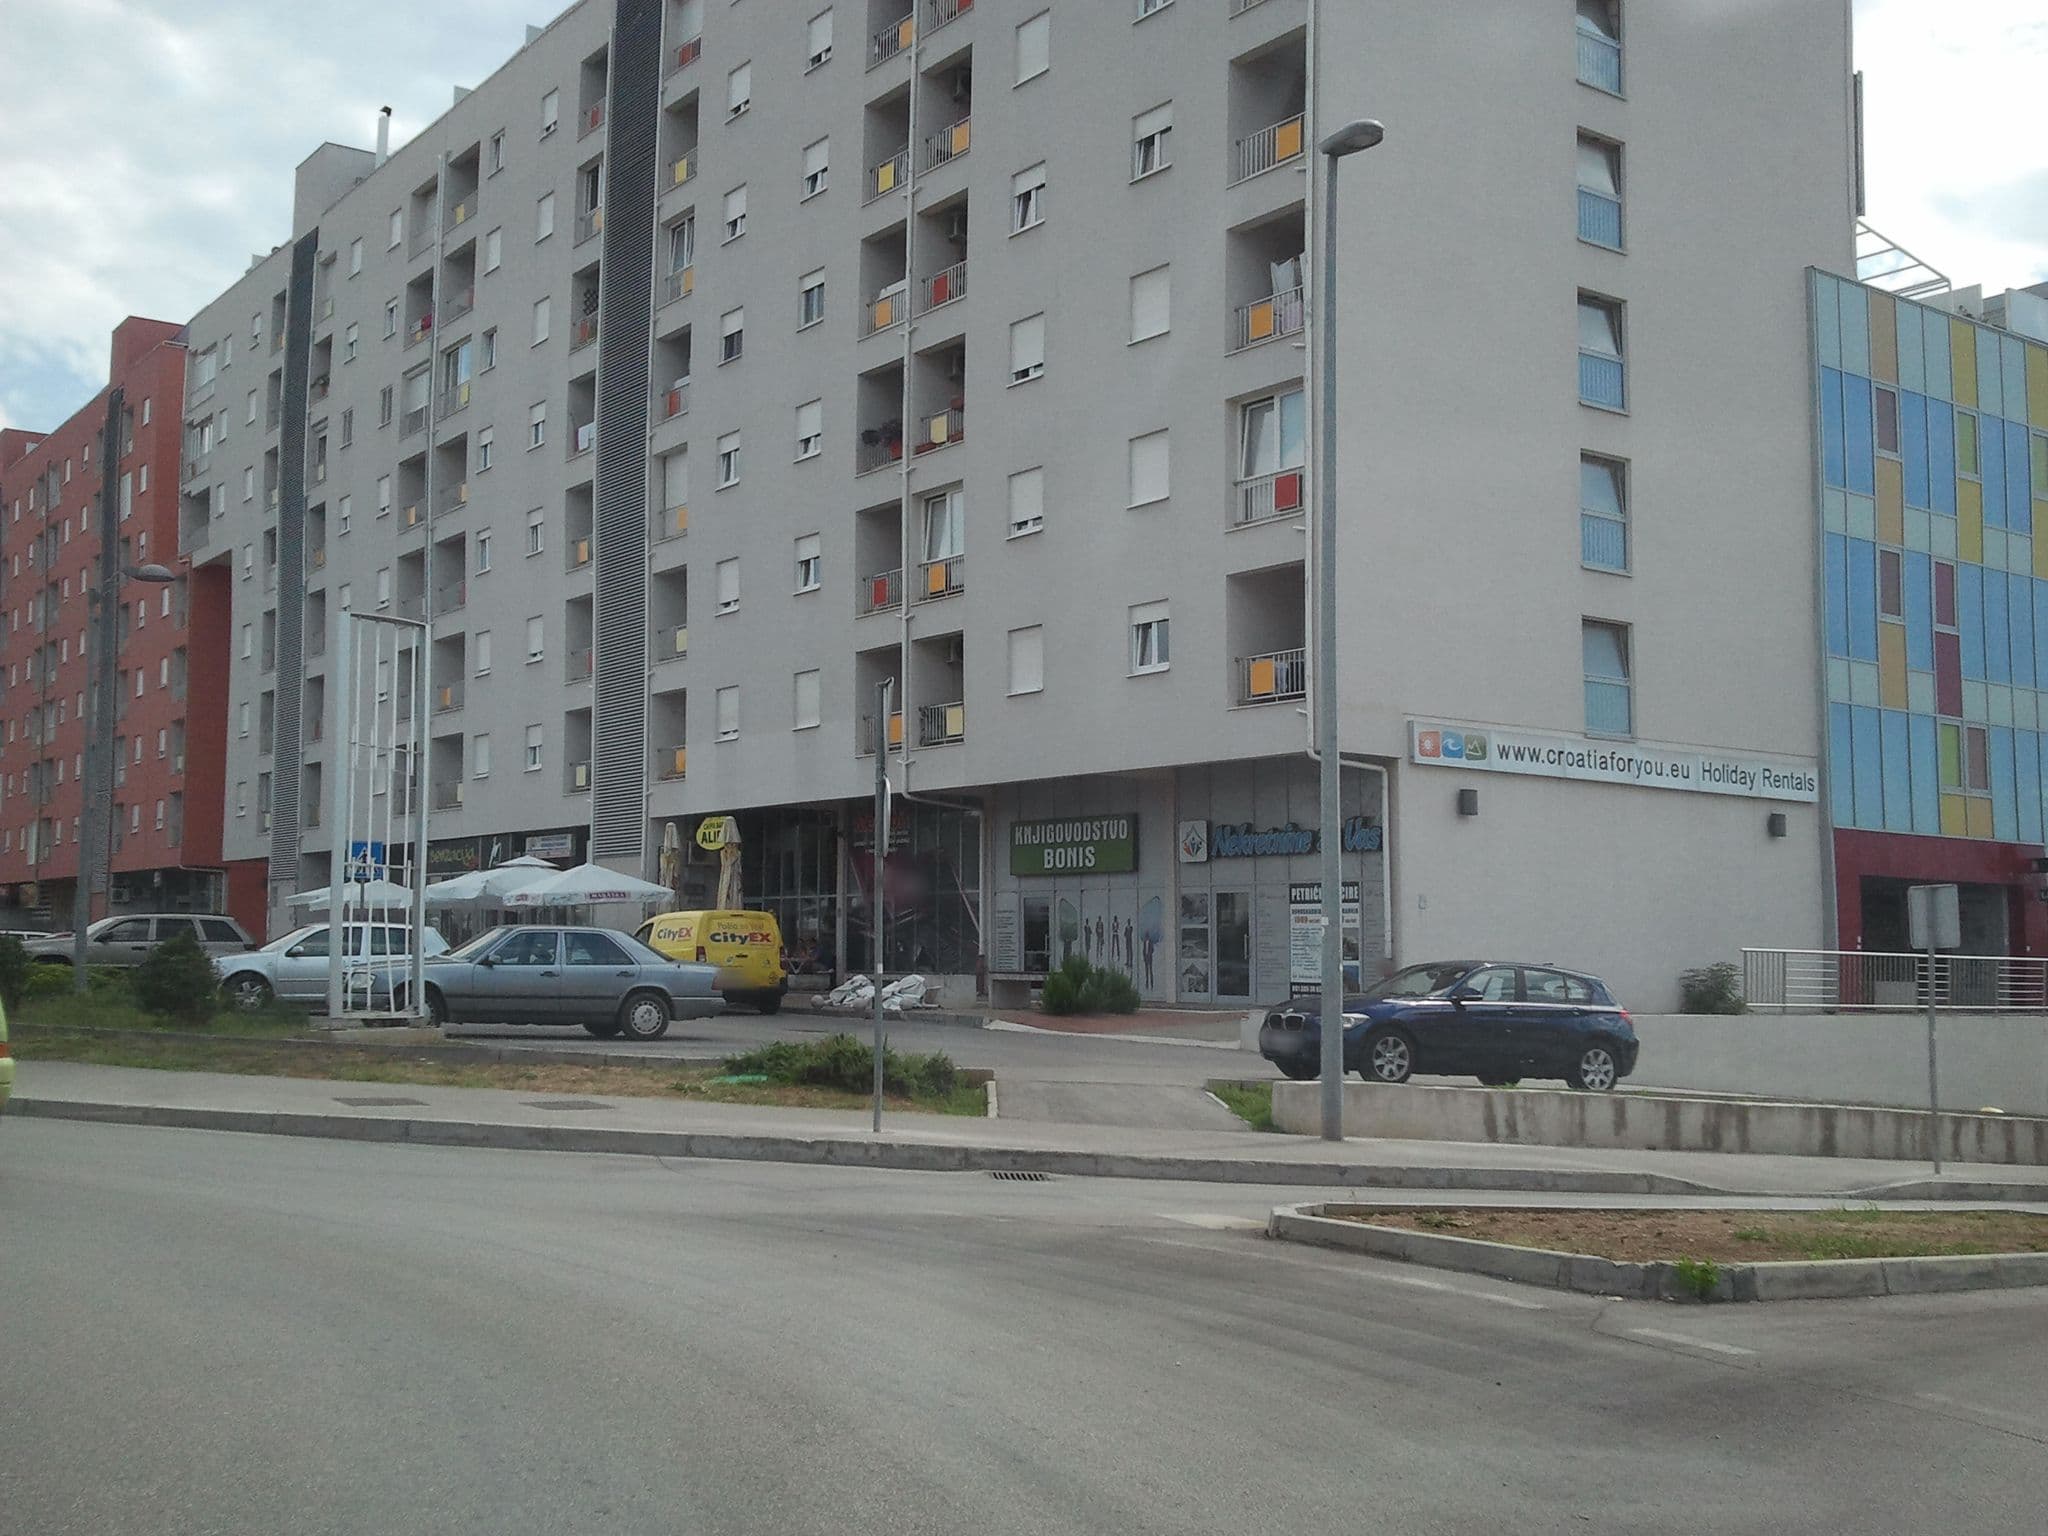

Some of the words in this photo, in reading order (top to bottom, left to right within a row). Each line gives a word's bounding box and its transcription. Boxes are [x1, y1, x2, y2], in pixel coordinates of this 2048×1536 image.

[1497, 743, 1690, 780] www.croatiaforyou.eu
[1702, 761, 1757, 791] Holiday
[1763, 767, 1816, 792] Rentals
[1015, 819, 1128, 845] KNJIGOVODSTVO
[1043, 846, 1096, 869] BONIS
[657, 926, 693, 941] CityEX
[709, 932, 772, 945] CityEX
